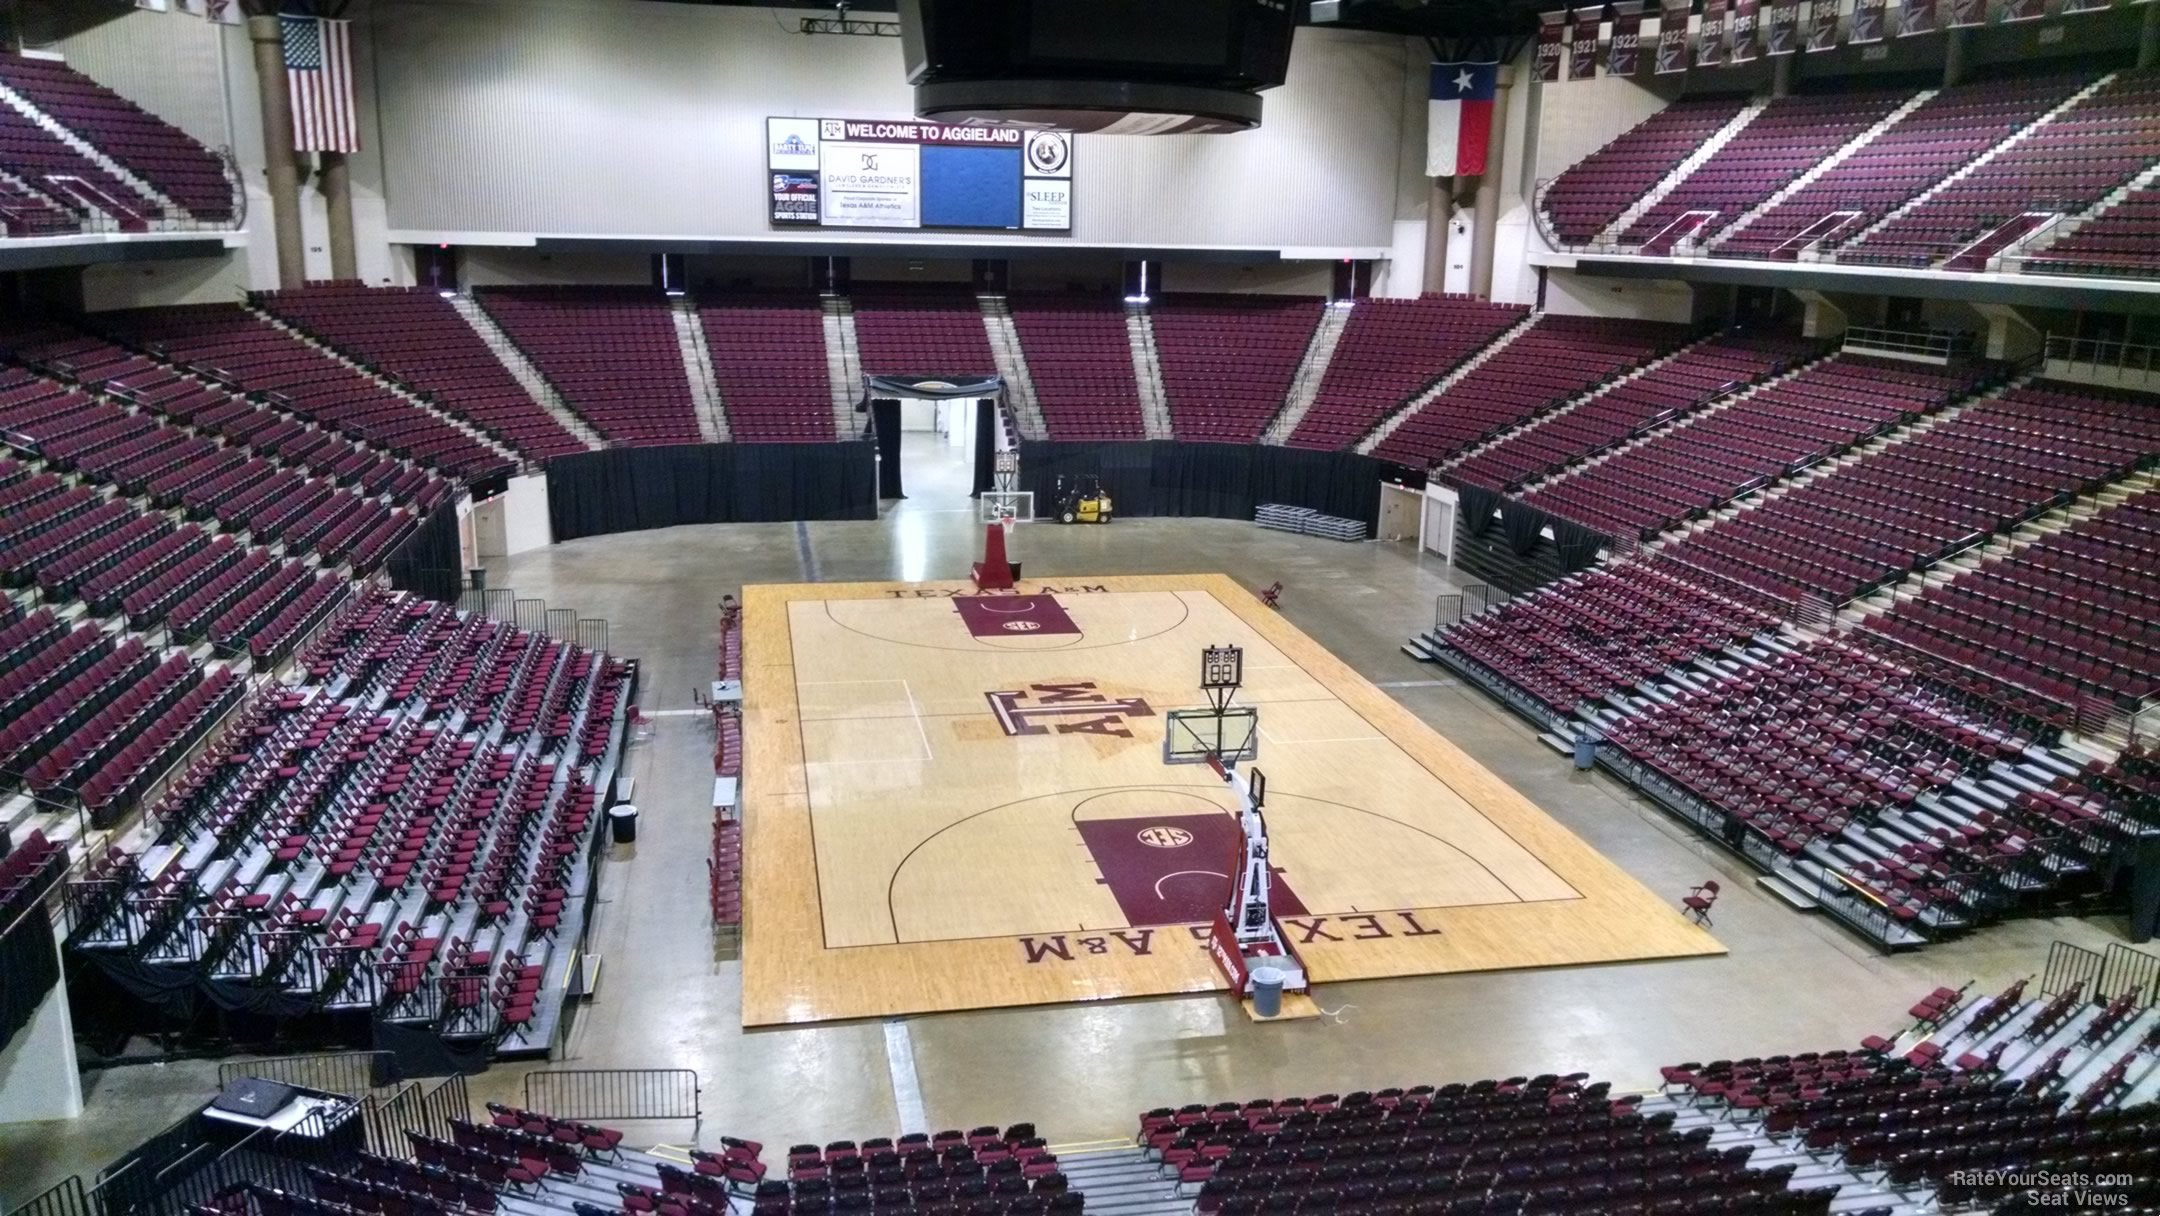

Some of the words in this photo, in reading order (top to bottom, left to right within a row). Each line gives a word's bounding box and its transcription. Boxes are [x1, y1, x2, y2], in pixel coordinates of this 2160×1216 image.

[1700, 20, 1723, 37] 1951
[1612, 34, 1638, 49] 1922
[1660, 29, 1686, 46] 1923
[1537, 43, 1561, 57] 1920
[1572, 39, 1597, 54] 1921
[846, 123, 918, 139] WELCOME
[920, 126, 939, 140] TO
[942, 127, 1019, 142] AGGIELAND
[828, 175, 857, 183] DAVID
[860, 176, 911, 185] GARDNER'S
[1030, 191, 1065, 202] SLEEP
[775, 201, 817, 212] AGGIE
[1005, 621, 1038, 632] SEC
[1141, 828, 1190, 847] SEC
[1020, 929, 1155, 963] A&M
